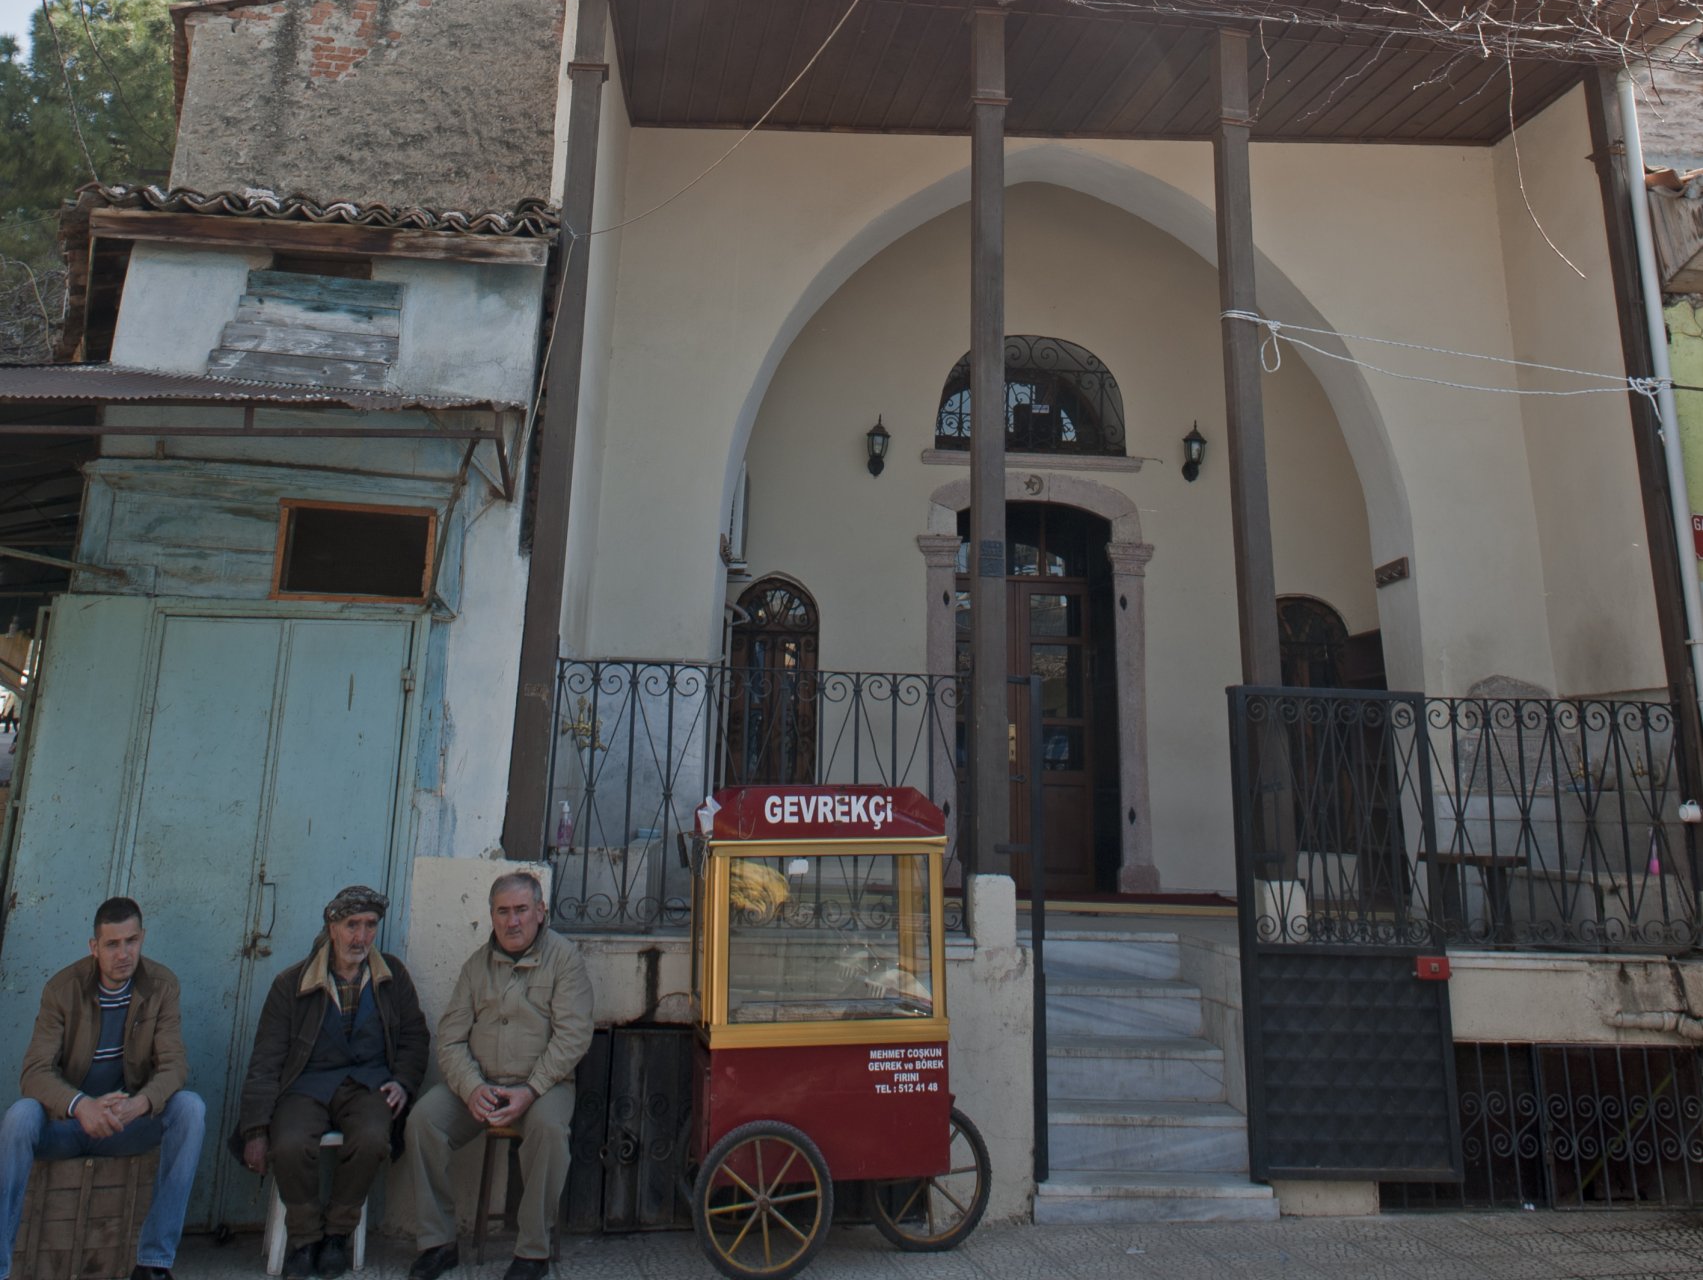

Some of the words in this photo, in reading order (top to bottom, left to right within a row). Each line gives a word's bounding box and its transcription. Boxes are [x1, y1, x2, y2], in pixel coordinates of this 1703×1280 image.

[870, 1049, 905, 1059] MEHMET
[907, 1048, 942, 1059] COŞKUN
[868, 1061, 902, 1071] GEVREK
[894, 1073, 919, 1082] FIRINI
[898, 1083, 914, 1093] 512
[915, 1083, 925, 1092] 41
[927, 1082, 938, 1092] 48
